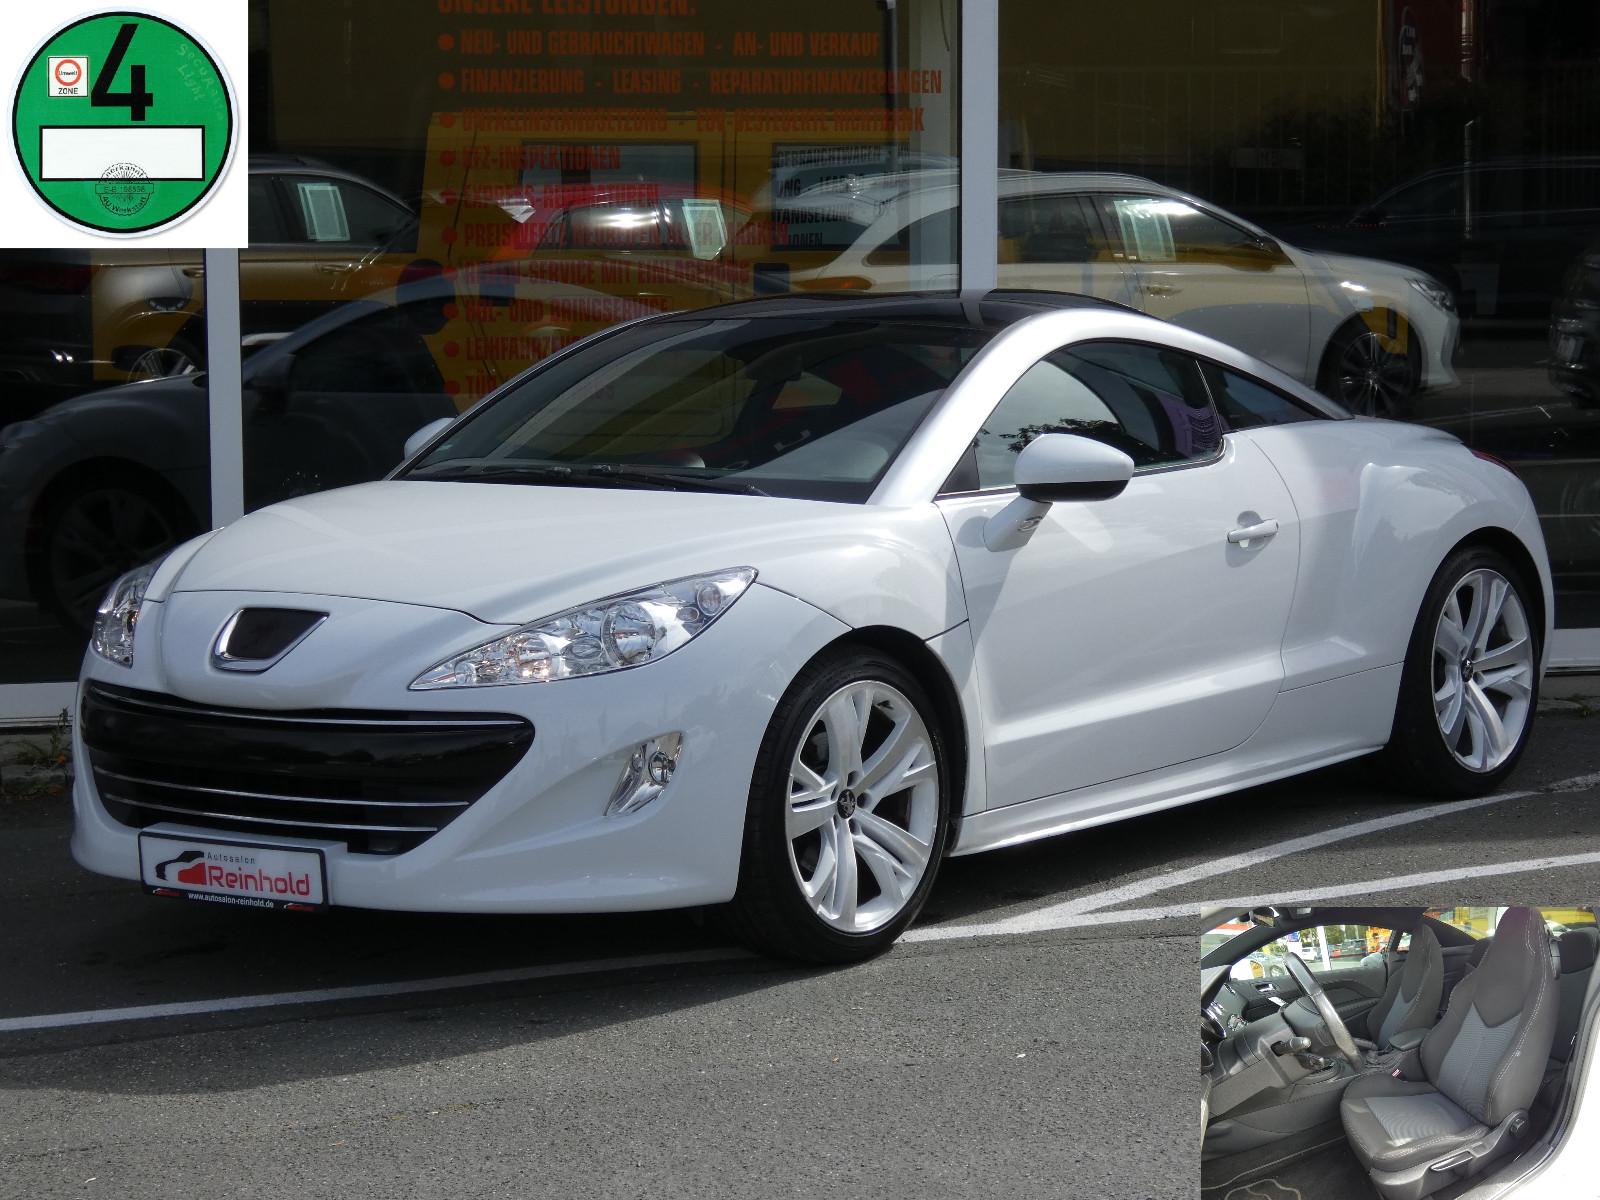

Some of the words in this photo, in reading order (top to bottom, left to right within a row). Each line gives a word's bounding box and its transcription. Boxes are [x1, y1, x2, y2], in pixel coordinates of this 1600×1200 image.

[507, 31, 543, 55] UND
[547, 31, 705, 55] GEBRAUCHTWAGEN
[769, 32, 804, 56] UND
[808, 32, 880, 56] VERKAUF
[460, 69, 584, 93] FINANZIERUNG
[612, 69, 682, 93] LEASING
[709, 69, 943, 94] REPARATURFINANZIERUNGEN
[206, 851, 256, 865] Autosalon
[207, 865, 311, 897] Reinhold
[187, 892, 275, 909] www.autosalon-reinhold.de
